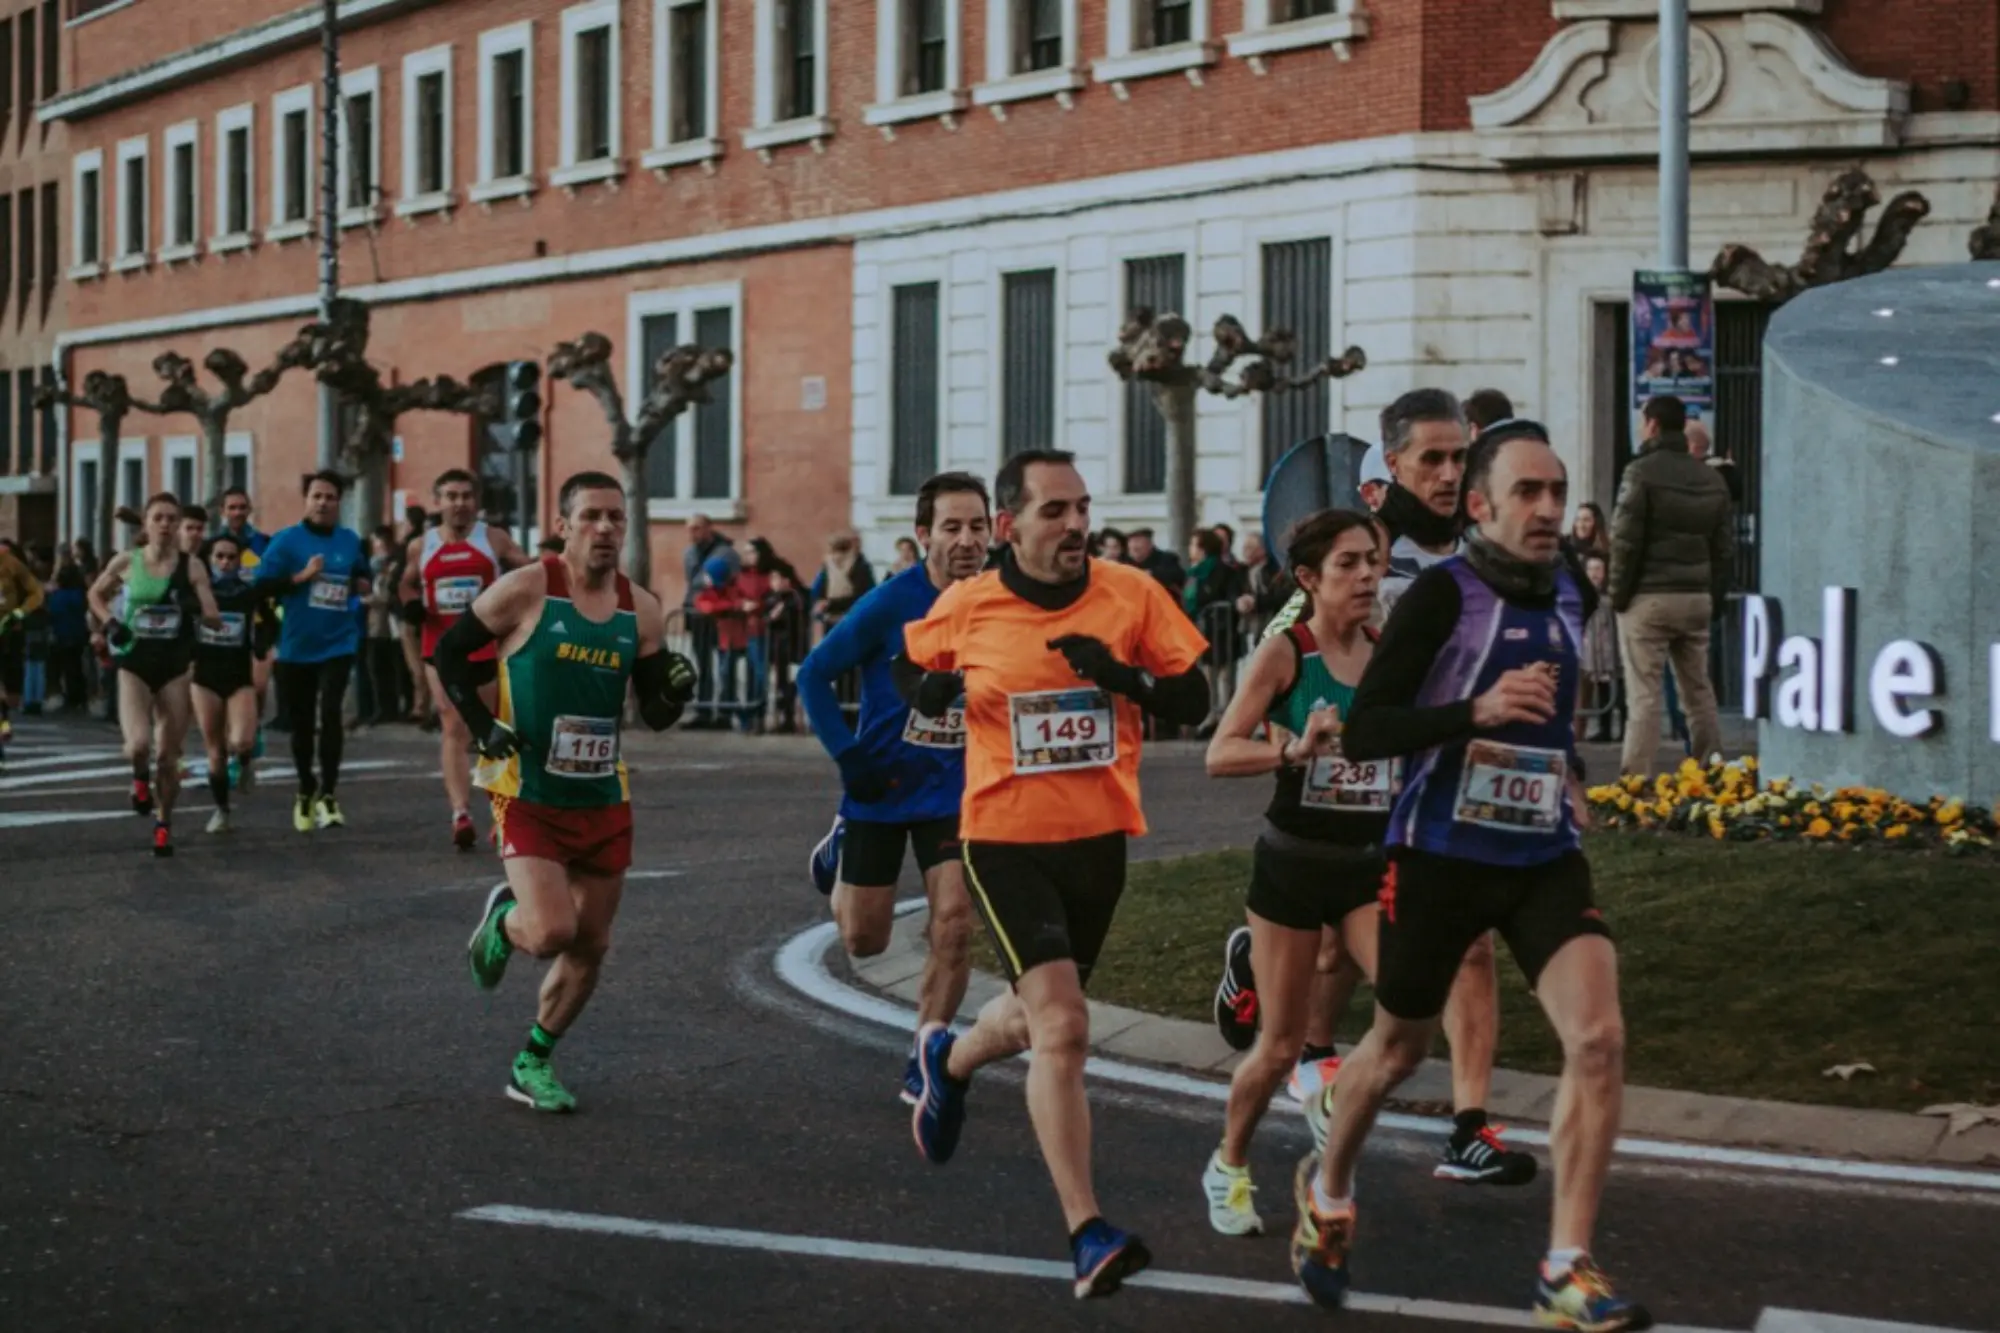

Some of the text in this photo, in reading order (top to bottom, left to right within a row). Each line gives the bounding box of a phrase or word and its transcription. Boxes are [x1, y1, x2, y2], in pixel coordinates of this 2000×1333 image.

[1743, 584, 2000, 742] Pale
[1037, 715, 1096, 743] 149
[572, 738, 610, 757] 116
[1328, 763, 1377, 786] 238
[1491, 773, 1544, 804] 100
